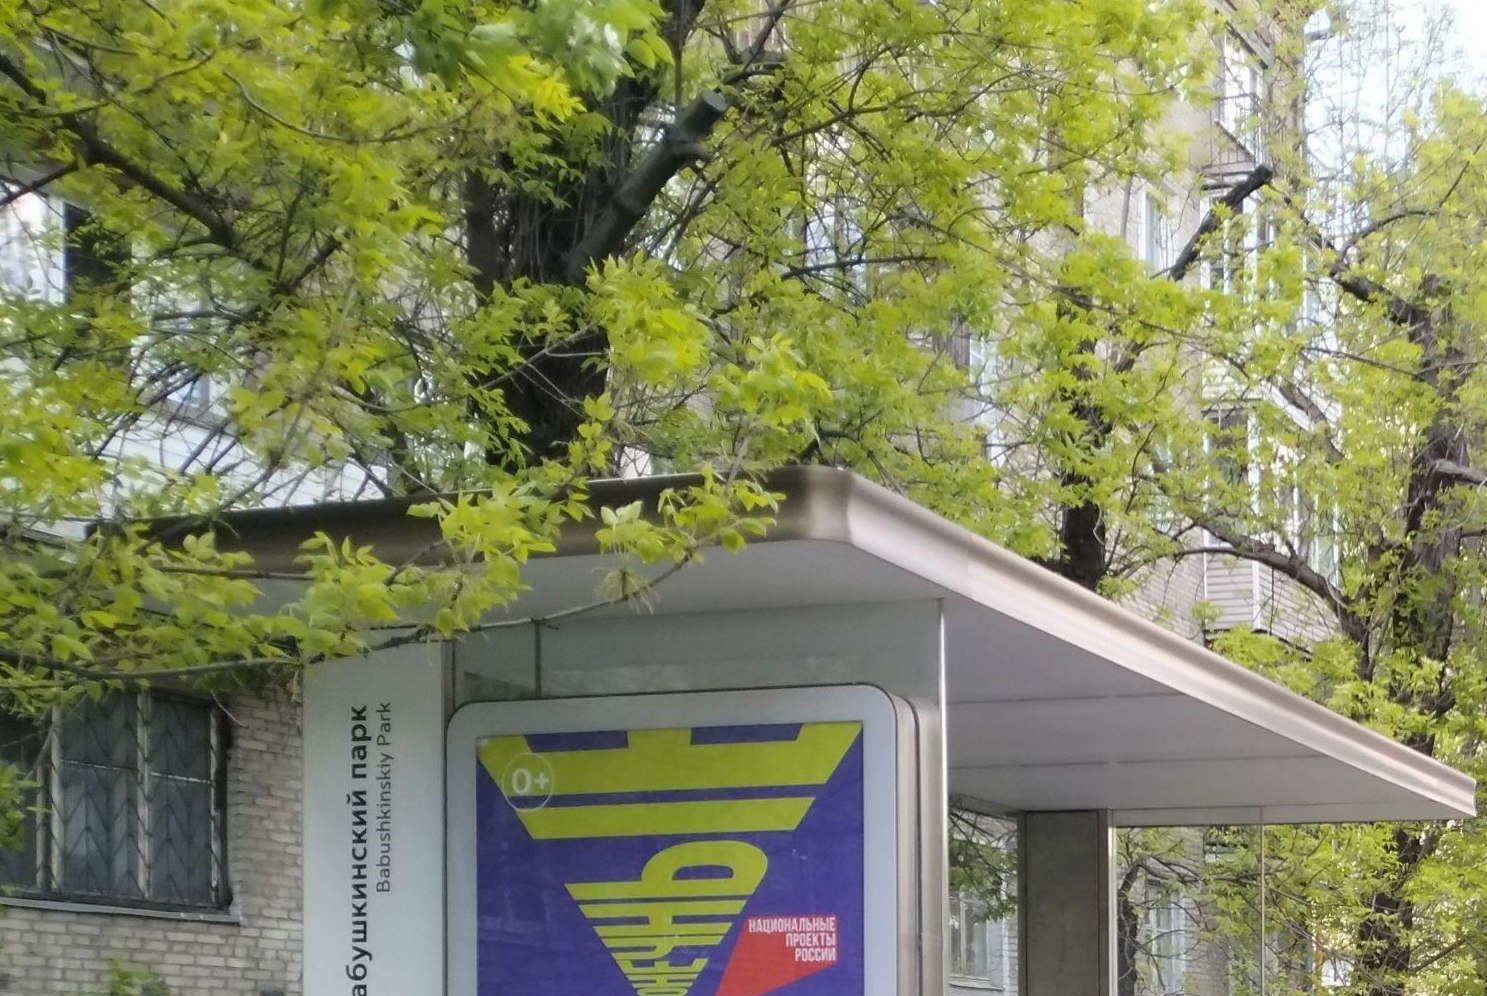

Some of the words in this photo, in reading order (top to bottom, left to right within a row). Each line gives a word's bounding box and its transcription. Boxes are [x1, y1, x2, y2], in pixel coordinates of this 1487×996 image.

[376, 702, 391, 746] Park
[351, 705, 372, 779] парк
[511, 767, 550, 795] 0+
[375, 752, 394, 892] Babushkinskiy
[748, 916, 836, 933] НАЦИОНАЛЬНЫЕ
[785, 932, 836, 948] ПРОЕКТЫ
[794, 947, 836, 962] РОССИИ
